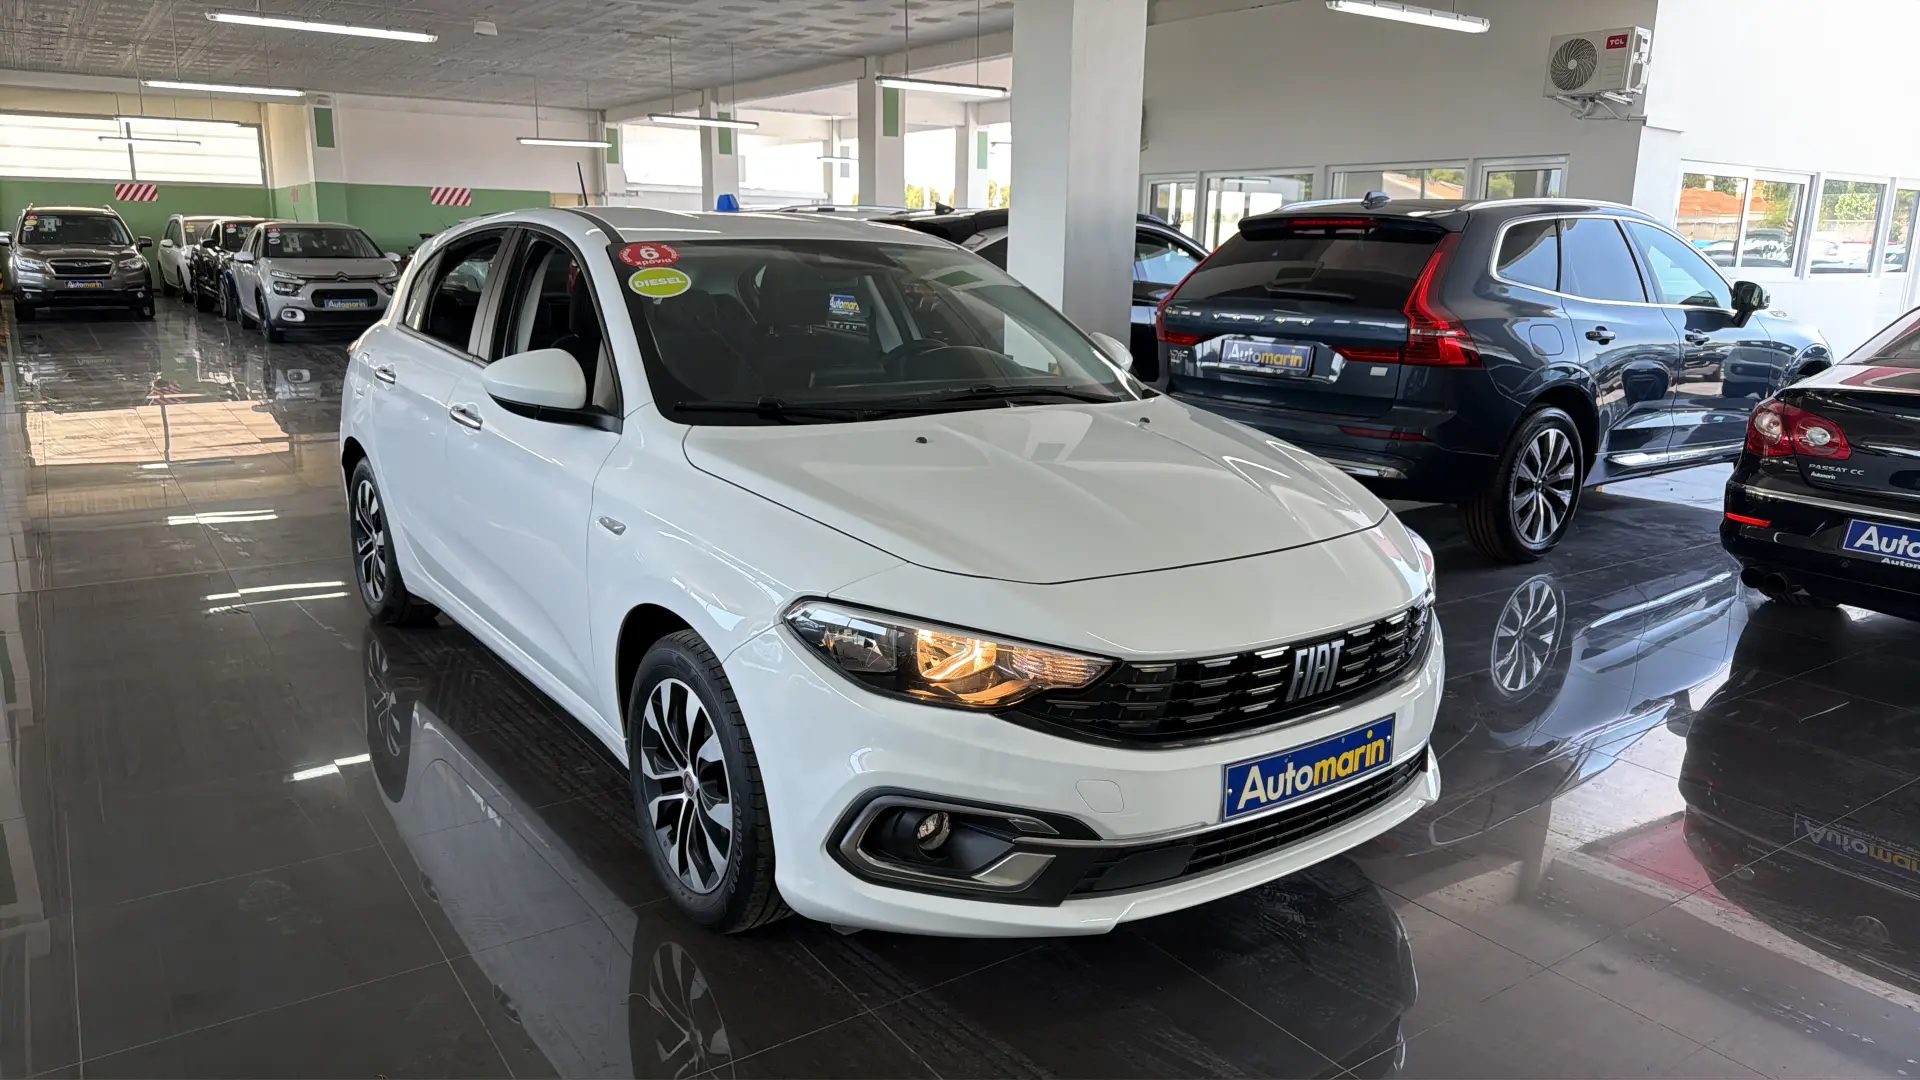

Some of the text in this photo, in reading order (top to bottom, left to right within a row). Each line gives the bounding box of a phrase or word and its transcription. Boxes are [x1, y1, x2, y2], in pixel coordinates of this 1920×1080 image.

[1609, 38, 1625, 46] TCL
[639, 247, 660, 260] 6
[634, 277, 686, 288] DIESEL
[327, 300, 367, 309] Automarin
[1227, 344, 1304, 368] Automarin
[1807, 463, 1865, 476] PASSAT CC
[1286, 639, 1345, 703] FIAT
[1237, 729, 1385, 811] Automarin
